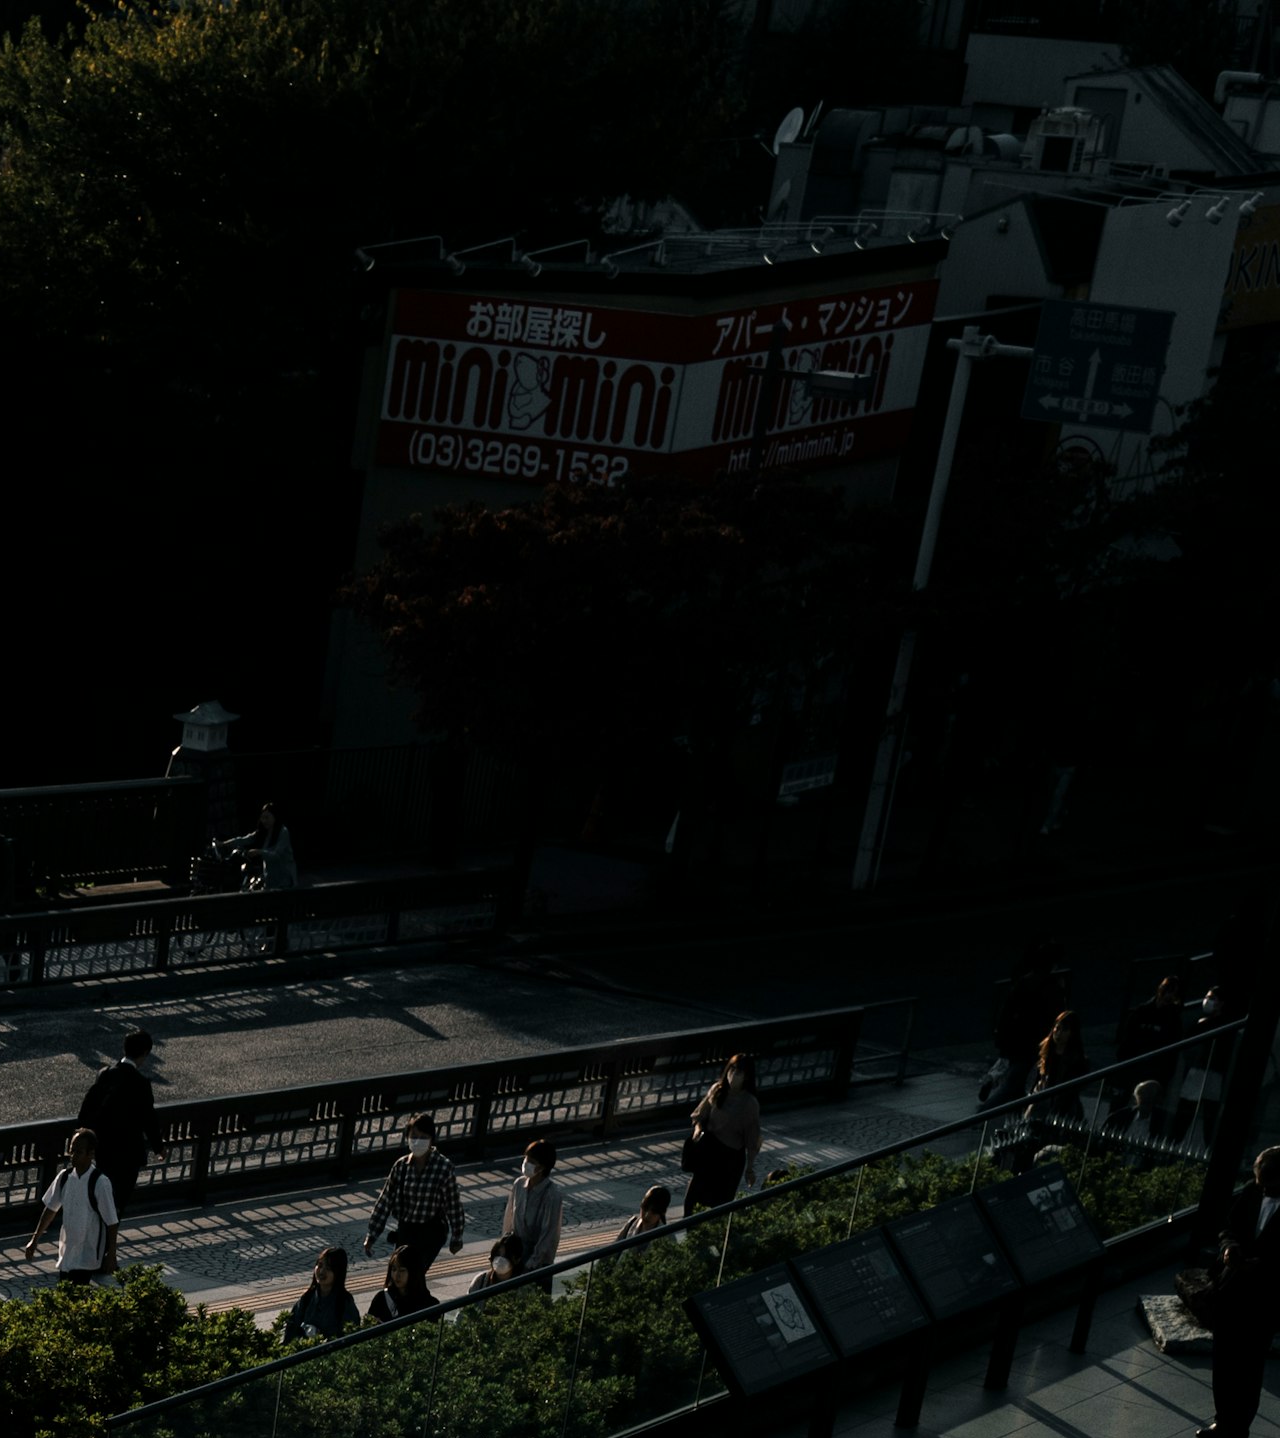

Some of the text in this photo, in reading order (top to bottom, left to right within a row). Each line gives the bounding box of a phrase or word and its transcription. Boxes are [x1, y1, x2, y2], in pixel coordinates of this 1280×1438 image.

[465, 301, 607, 349] お部屋探し
[711, 290, 915, 355] アパート・マンション
[388, 337, 675, 449] mini mini
[408, 429, 630, 488] (03)3269-1532
[727, 428, 855, 475] htt://minimini.jp
